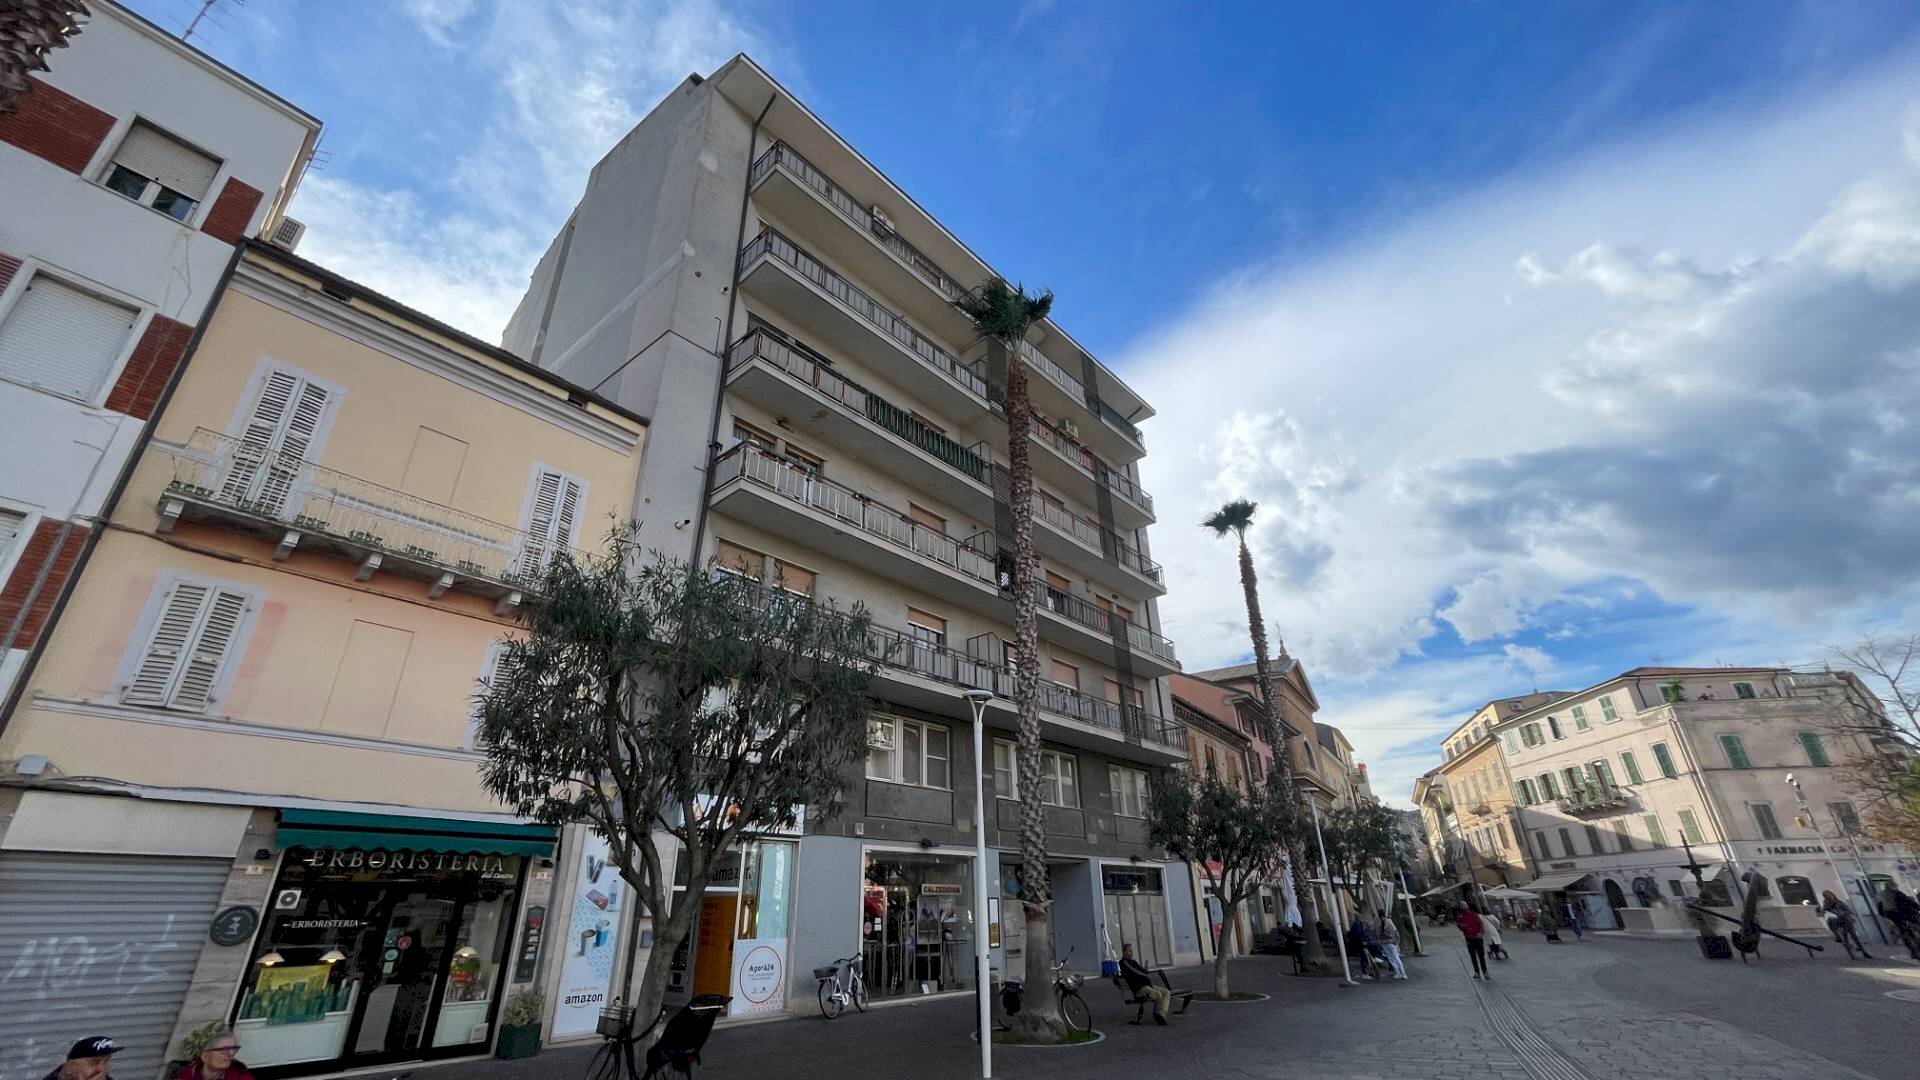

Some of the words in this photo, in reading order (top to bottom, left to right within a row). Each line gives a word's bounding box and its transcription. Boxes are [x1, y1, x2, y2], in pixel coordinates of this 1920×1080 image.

[1766, 845, 1825, 855] FARMACIA
[310, 849, 504, 872] ERBORISTERIA
[712, 867, 752, 881] amazn
[291, 918, 359, 929] ERBORISTERIA
[564, 993, 603, 1005] amazon
